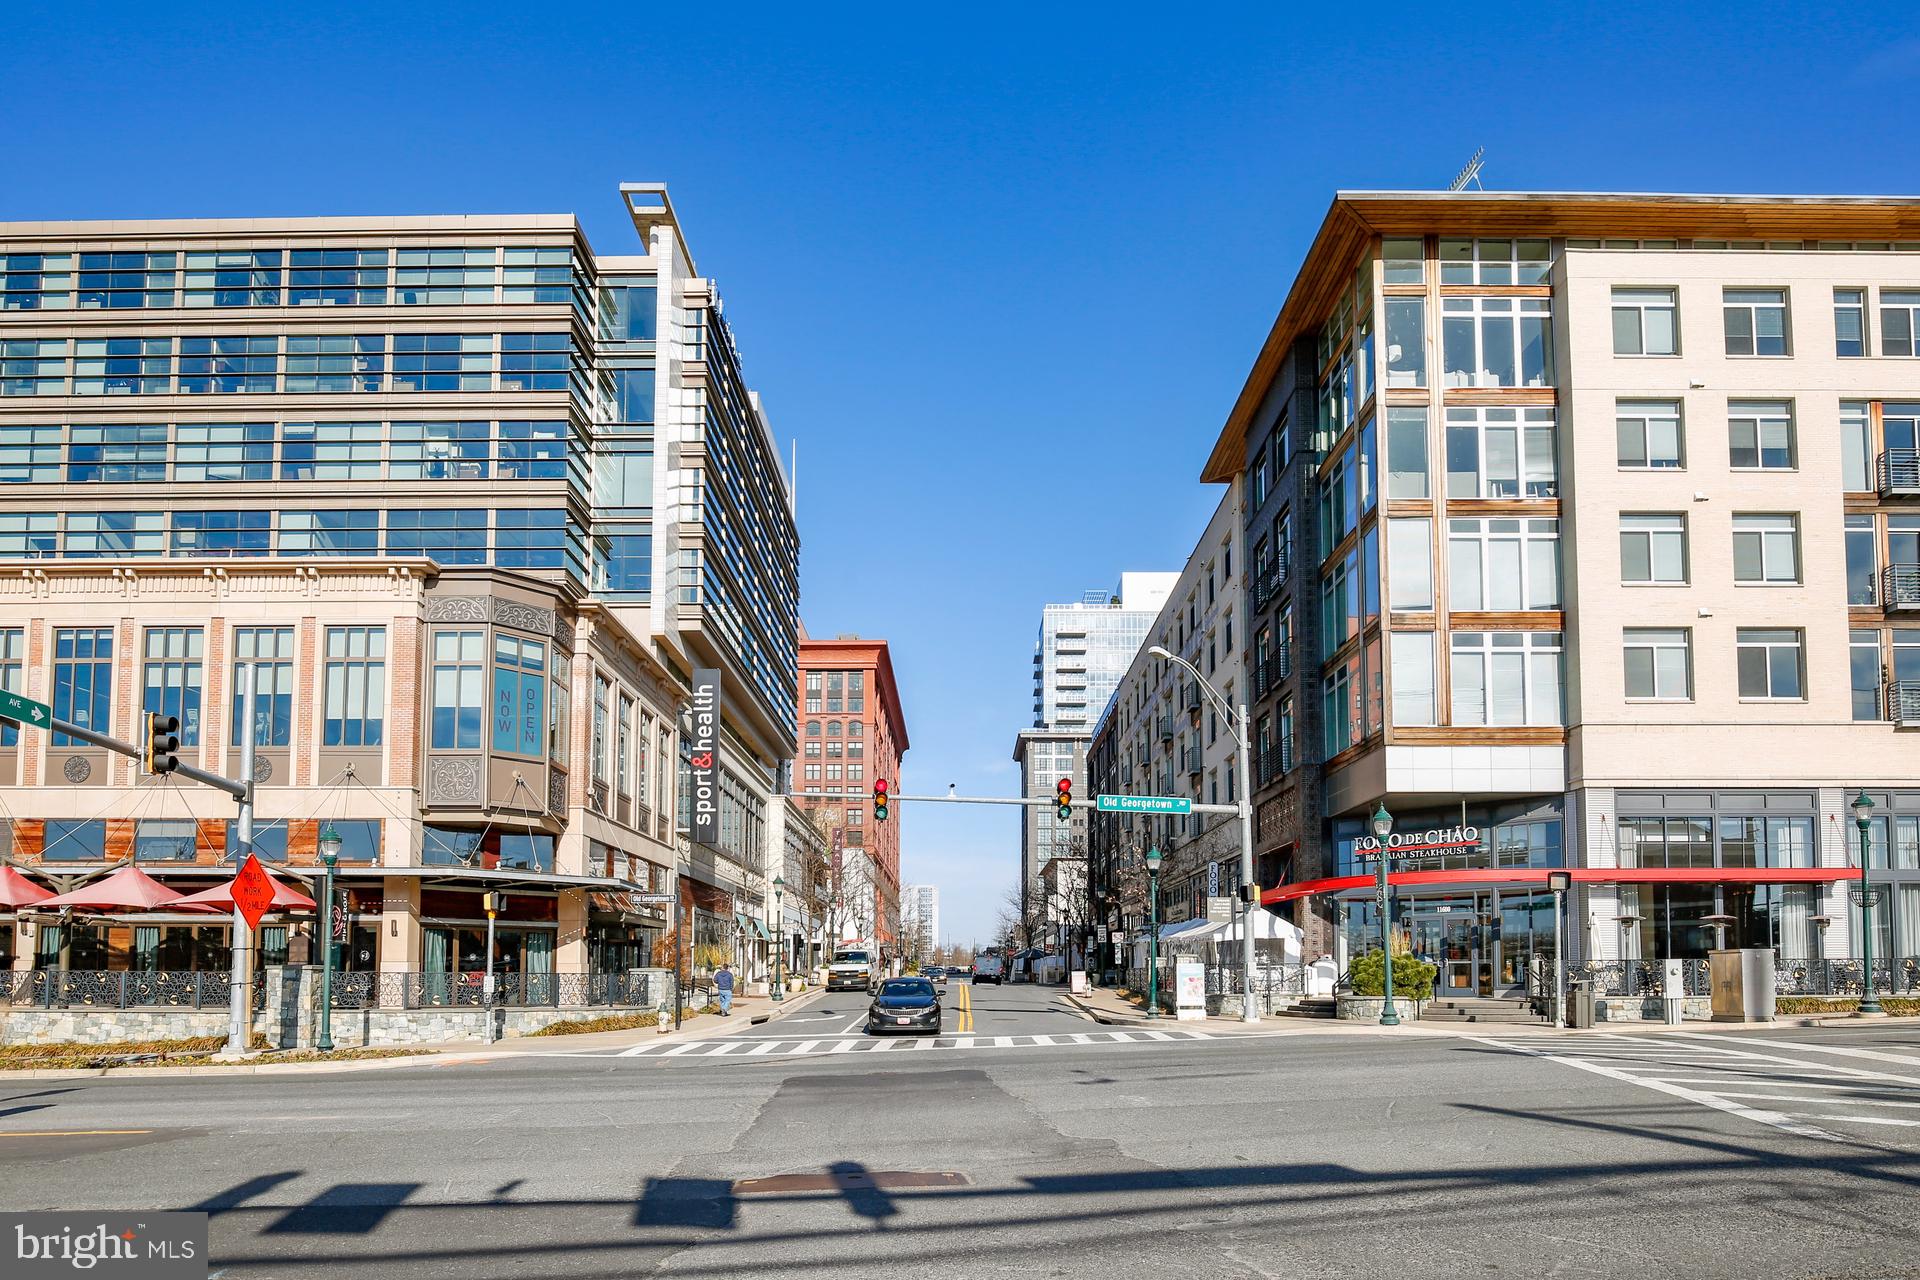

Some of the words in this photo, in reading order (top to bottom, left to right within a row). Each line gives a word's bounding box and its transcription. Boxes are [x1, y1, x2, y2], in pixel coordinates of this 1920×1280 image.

[9, 698, 22, 709] AVE
[499, 689, 511, 733] NOW
[525, 688, 535, 743] OPEN
[692, 684, 717, 825] sport&health
[1103, 797, 1118, 807] Old
[1121, 798, 1172, 811] Georgetown
[1354, 833, 1402, 851] FOO
[1405, 833, 1423, 845] DE
[1425, 825, 1478, 845] CHÃO
[1366, 851, 1407, 862] BRAIAN
[1409, 847, 1468, 859] STEAKHOUSE
[244, 872, 262, 882] ROAD
[244, 887, 262, 897] WORK
[251, 901, 265, 911] MILE
